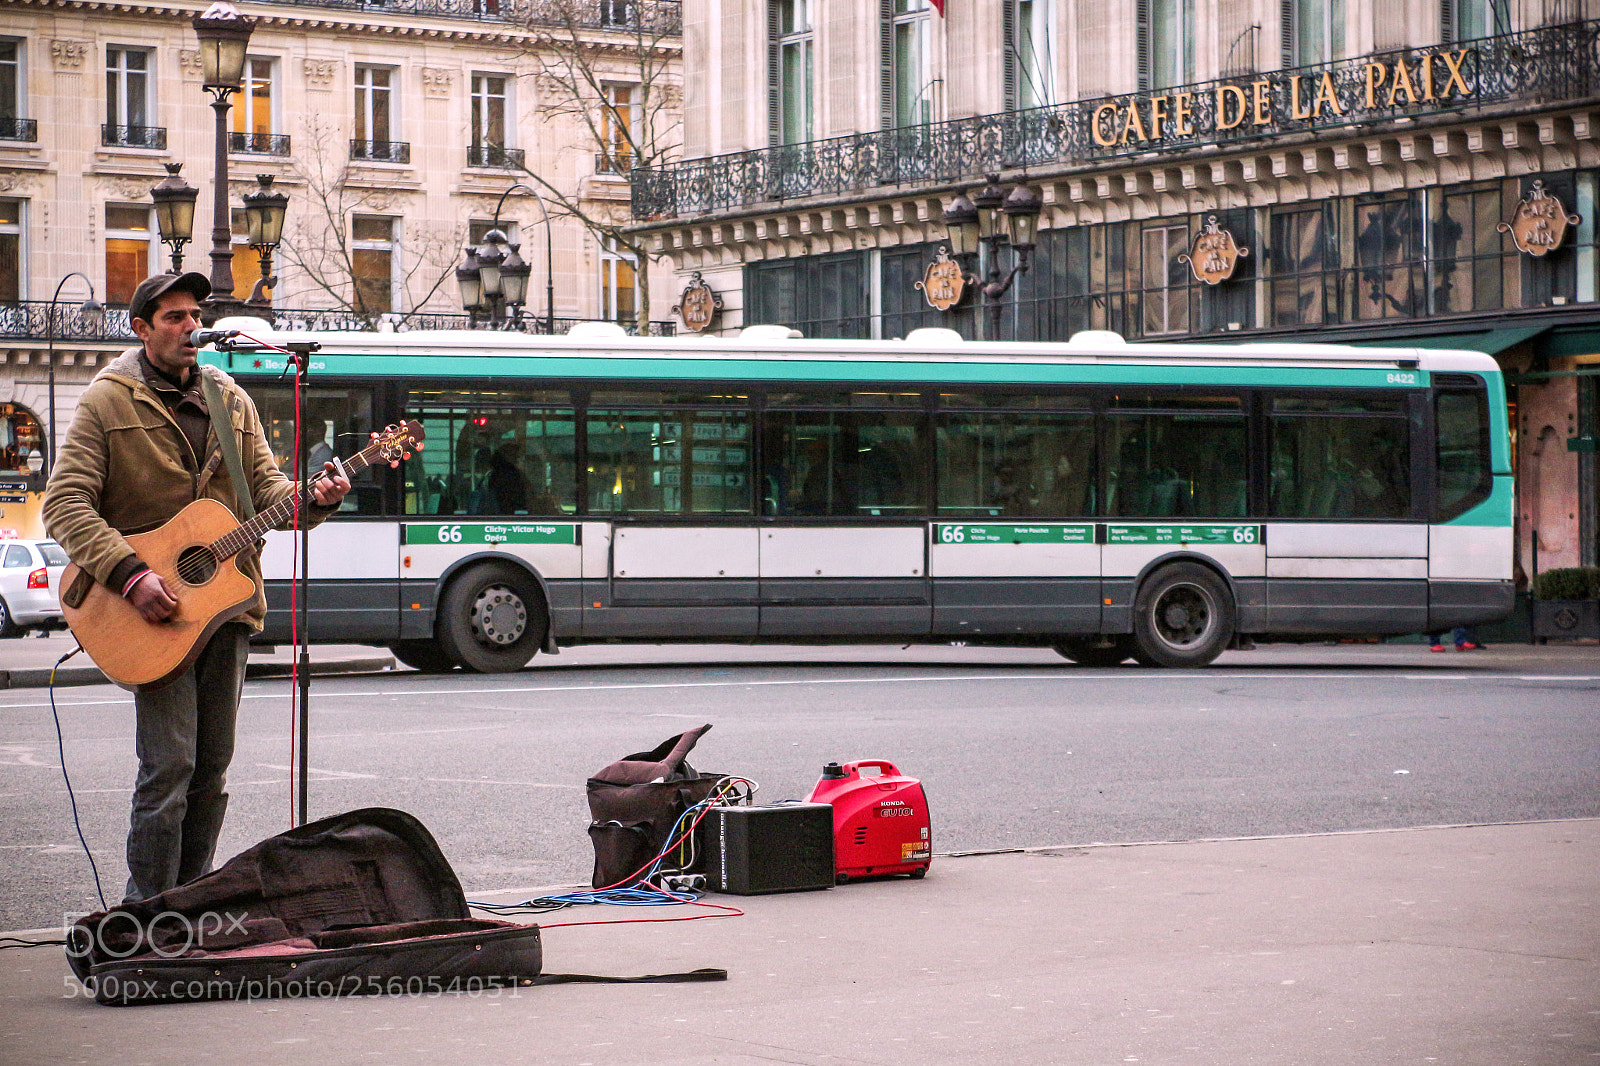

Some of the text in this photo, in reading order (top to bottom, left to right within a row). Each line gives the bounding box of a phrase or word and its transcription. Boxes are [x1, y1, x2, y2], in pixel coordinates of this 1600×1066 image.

[1092, 49, 1472, 146] CAFE DE LA PAIX
[1387, 373, 1415, 384] 8422
[437, 525, 463, 543] 66
[484, 534, 508, 542] Opéra
[536, 526, 556, 535] Hugo
[942, 526, 965, 543] 66
[1232, 526, 1255, 543] 66
